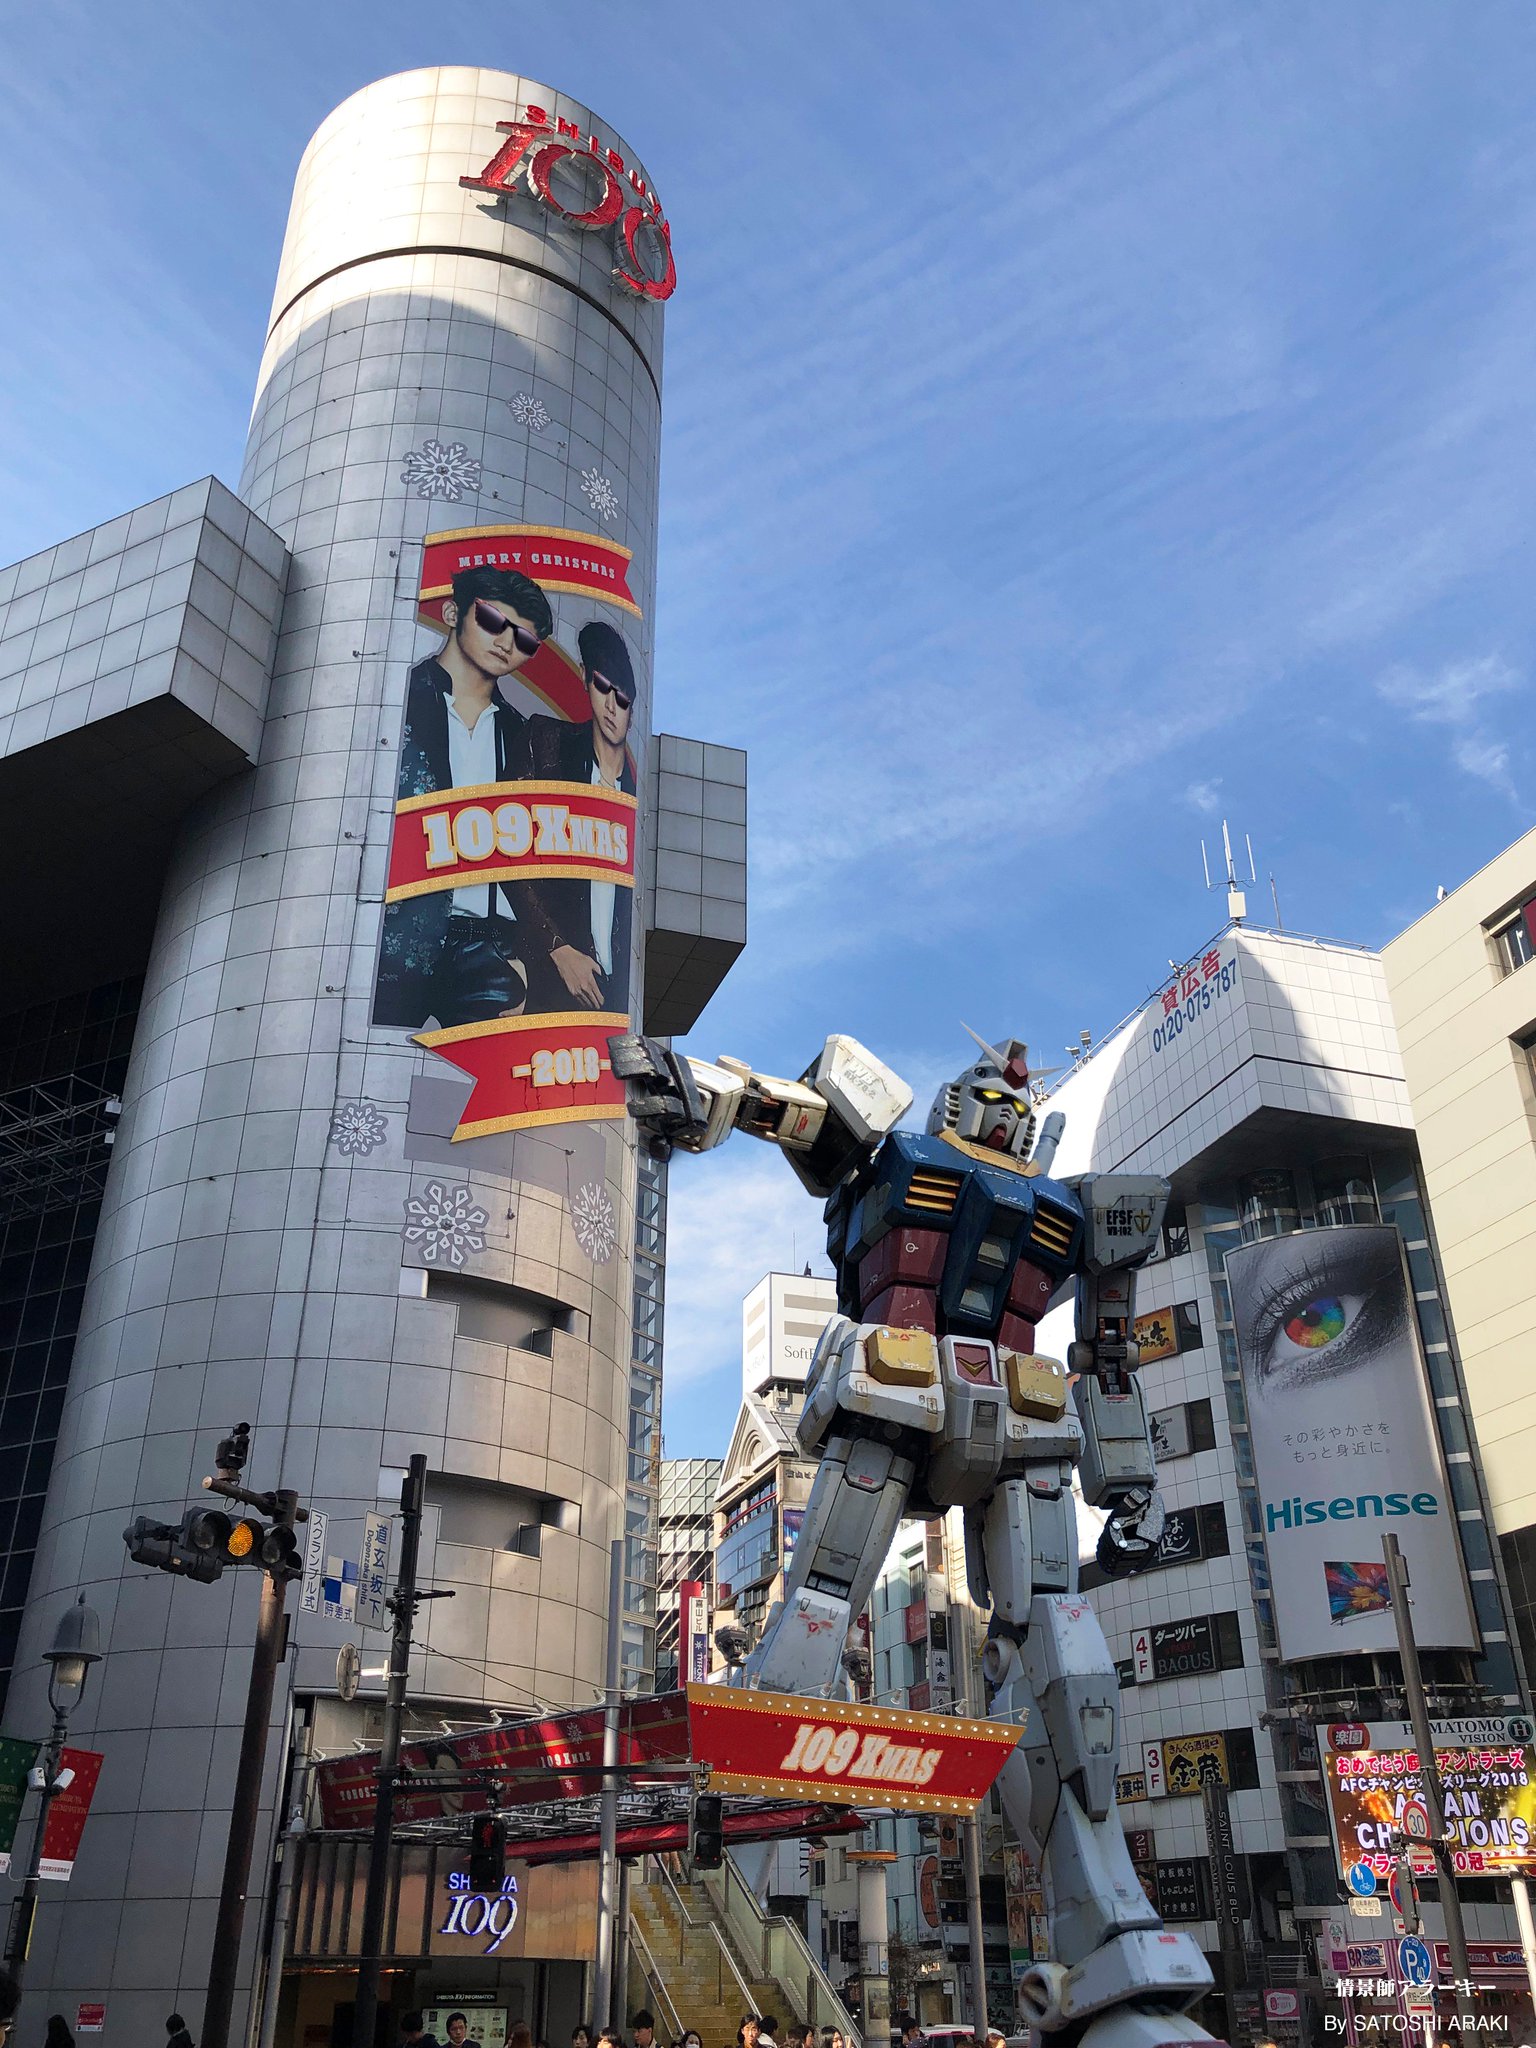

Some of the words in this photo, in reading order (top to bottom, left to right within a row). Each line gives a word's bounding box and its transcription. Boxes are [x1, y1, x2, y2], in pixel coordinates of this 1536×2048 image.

[524, 104, 671, 246] SHIBUYA
[458, 121, 677, 302] 109
[458, 553, 521, 568] MERRY
[531, 553, 615, 579] CHRISTMAS
[1160, 948, 1221, 1017] 貸広告
[1152, 958, 1236, 1053] 0120-075-787
[1106, 1209, 1134, 1226] EFSF
[1283, 1422, 1390, 1447] その彩やかさを
[1293, 1441, 1391, 1463] もっと身近に。
[1266, 1492, 1438, 1533] Hisense
[304, 1514, 325, 1611] スクランブル式
[369, 1522, 389, 1620] 道玄坂下
[359, 1579, 369, 1606] shita
[324, 1601, 353, 1623] 時差式
[1155, 1623, 1207, 1646] ダーツバー
[1158, 1651, 1211, 1675] BAGUS
[1403, 1719, 1505, 1735] HMATOMO
[1459, 1733, 1506, 1744] VISION
[1169, 1752, 1223, 1788] 金の蔵
[1218, 1811, 1230, 1849] SAINT
[1407, 1813, 1426, 1836] 30
[1159, 1867, 1192, 1878] 鉄板焼き
[1224, 1854, 1236, 1893] LOUIS
[1160, 1884, 1195, 1896] しゃぶしゃぶ
[1163, 1902, 1196, 1912] すき焼き
[1229, 1898, 1240, 1924] BLD
[441, 1894, 518, 1954] 109
[1405, 1949, 1418, 1982] P
